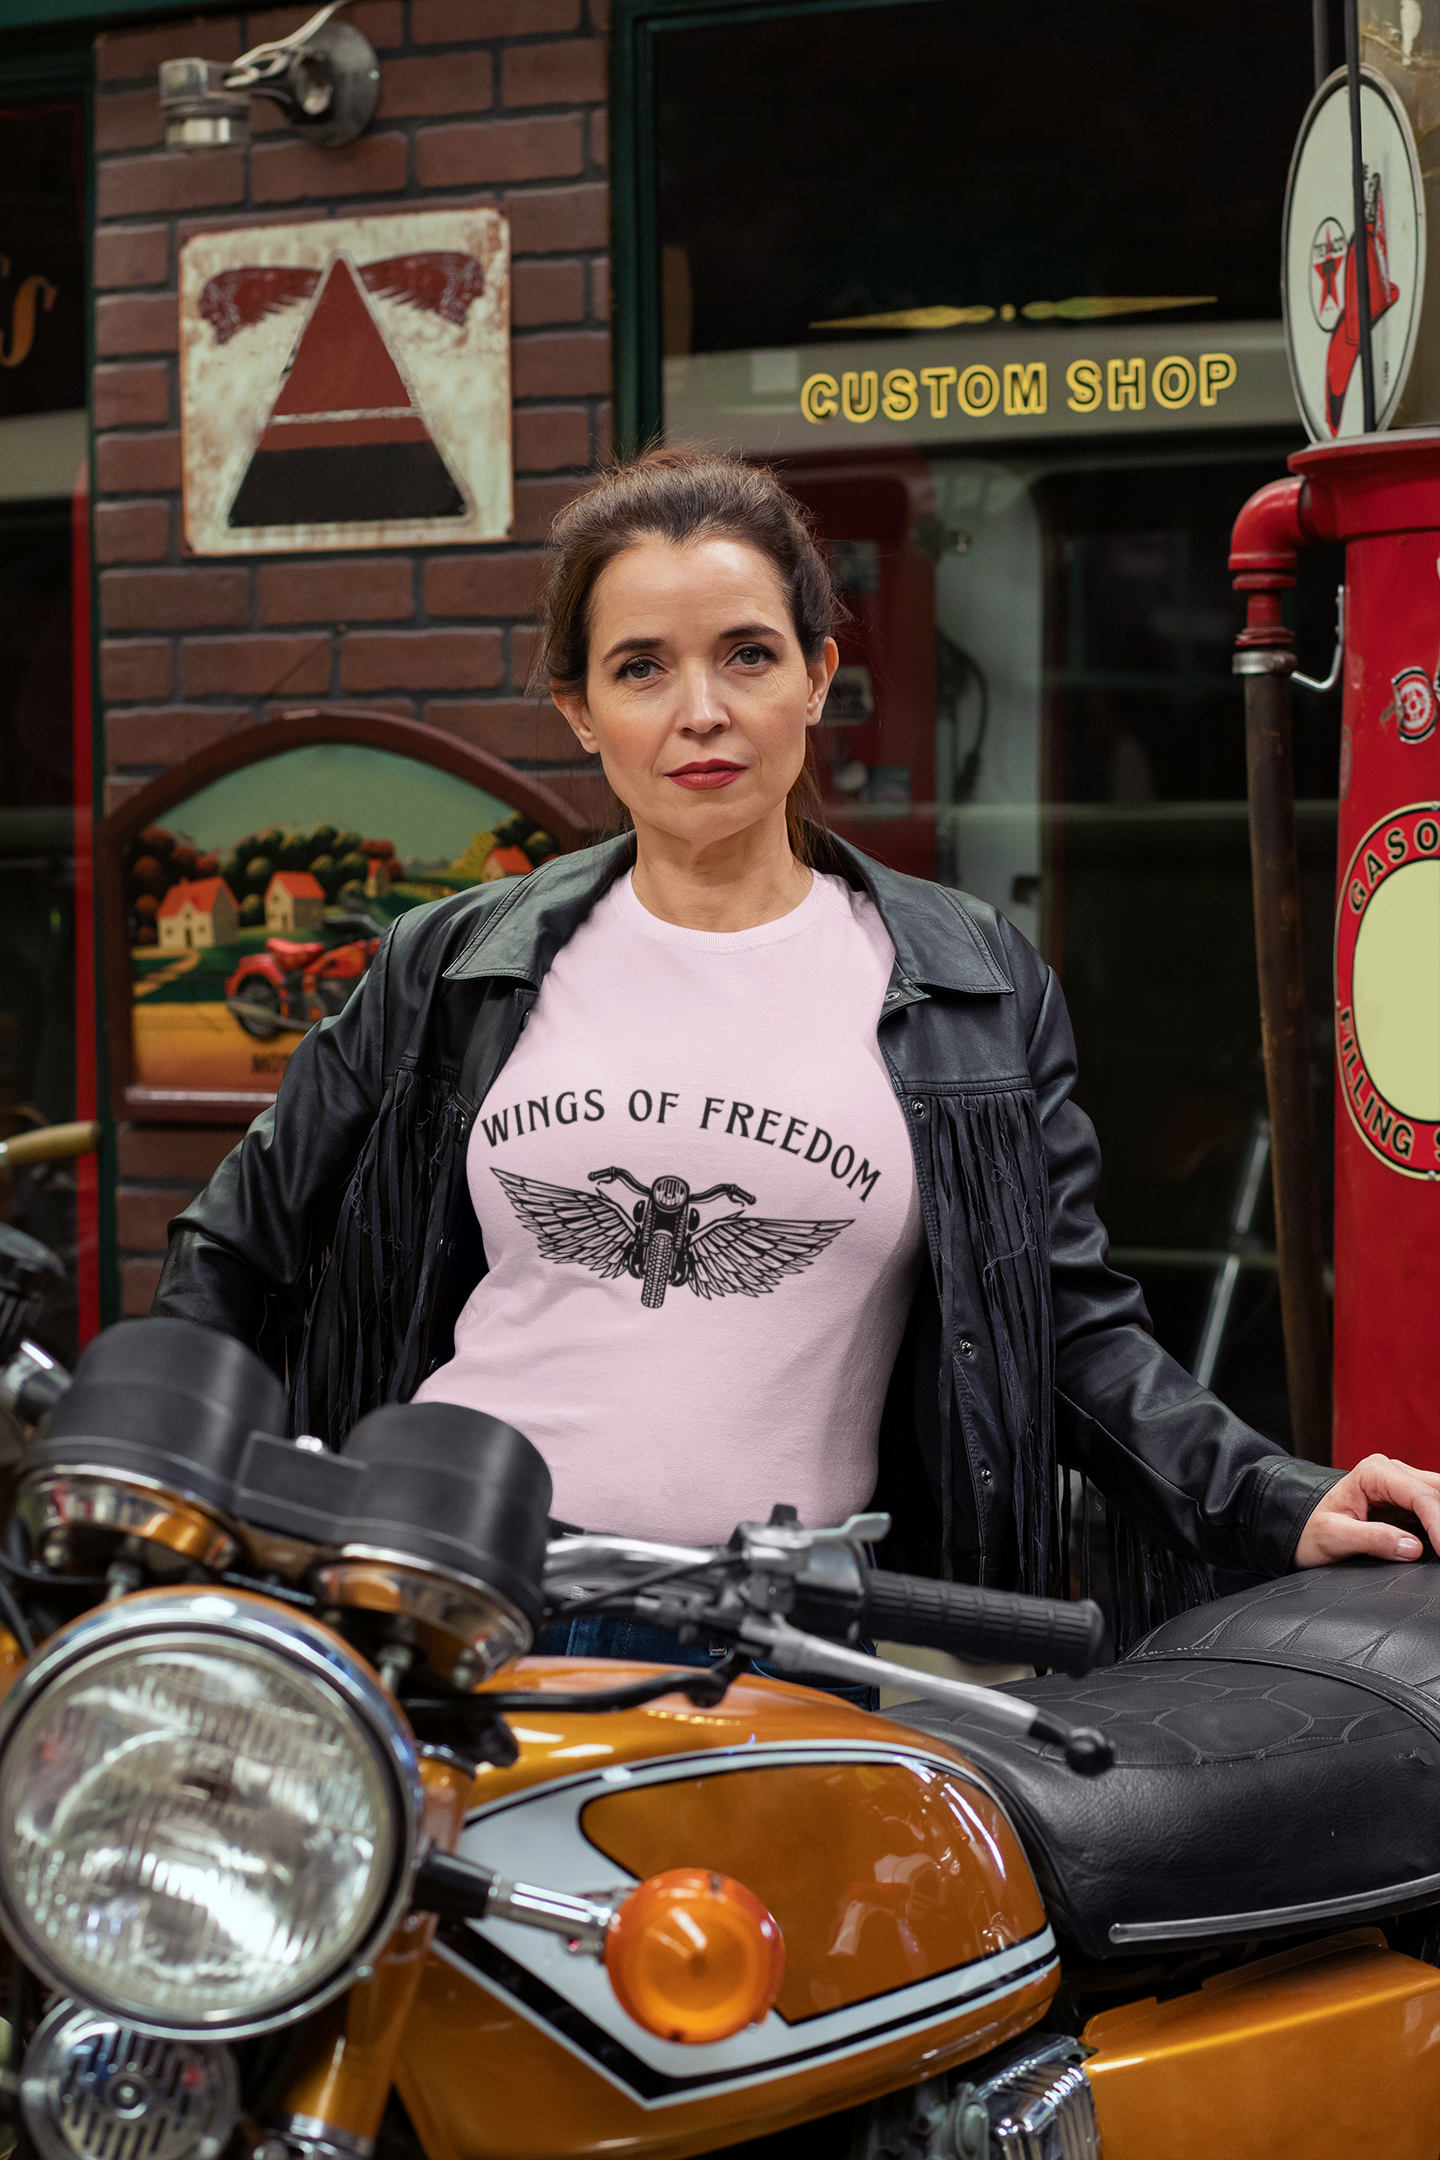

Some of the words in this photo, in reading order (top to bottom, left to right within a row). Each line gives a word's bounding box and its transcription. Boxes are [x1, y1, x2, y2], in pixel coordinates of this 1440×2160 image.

[800, 362, 1048, 425] CUSTOM
[1065, 353, 1237, 413] SHOP
[1350, 821, 1440, 914] GASO
[1341, 1006, 1414, 1160] FILLING
[481, 1089, 605, 1147] WINGS
[628, 1089, 680, 1124] OF
[700, 1097, 882, 1202] FREEDOM
